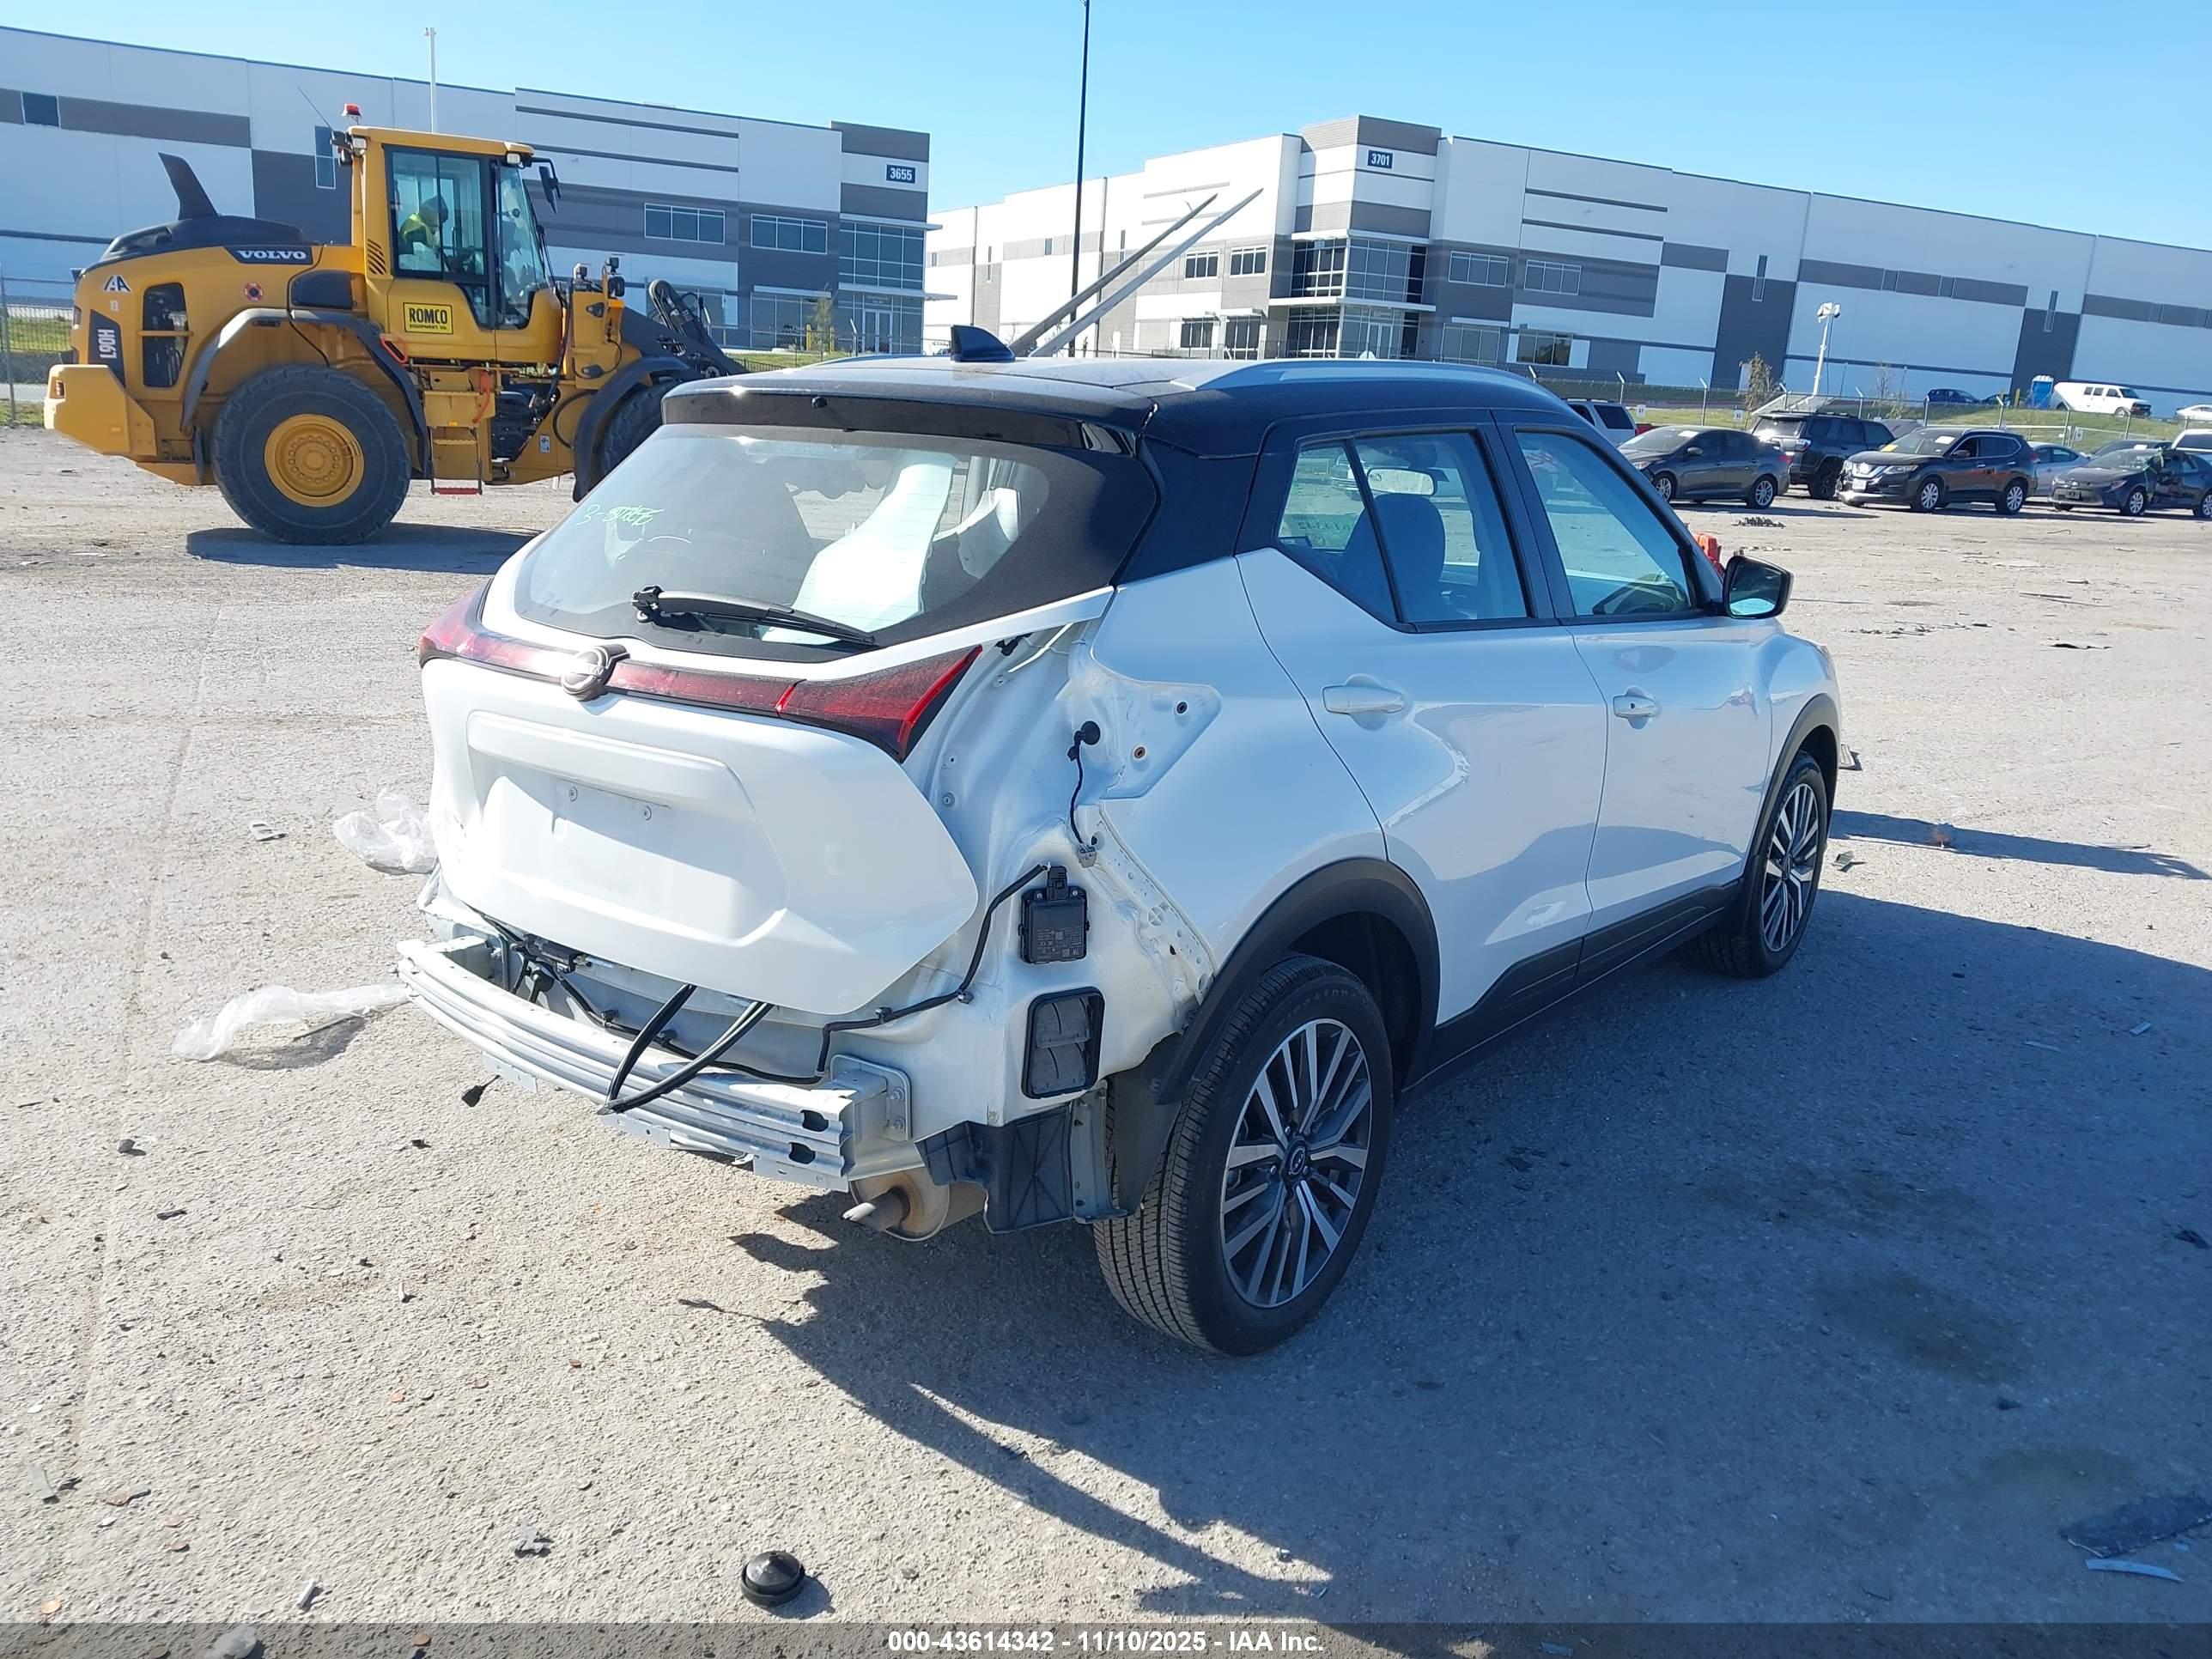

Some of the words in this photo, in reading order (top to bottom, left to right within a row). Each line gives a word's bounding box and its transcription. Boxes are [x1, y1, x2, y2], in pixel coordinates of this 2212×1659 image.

[1371, 153, 1390, 166] 3701
[890, 167, 913, 181] 3655
[236, 250, 307, 260] VOLVO
[409, 307, 447, 324] ROMCO
[97, 328, 118, 359] L90H
